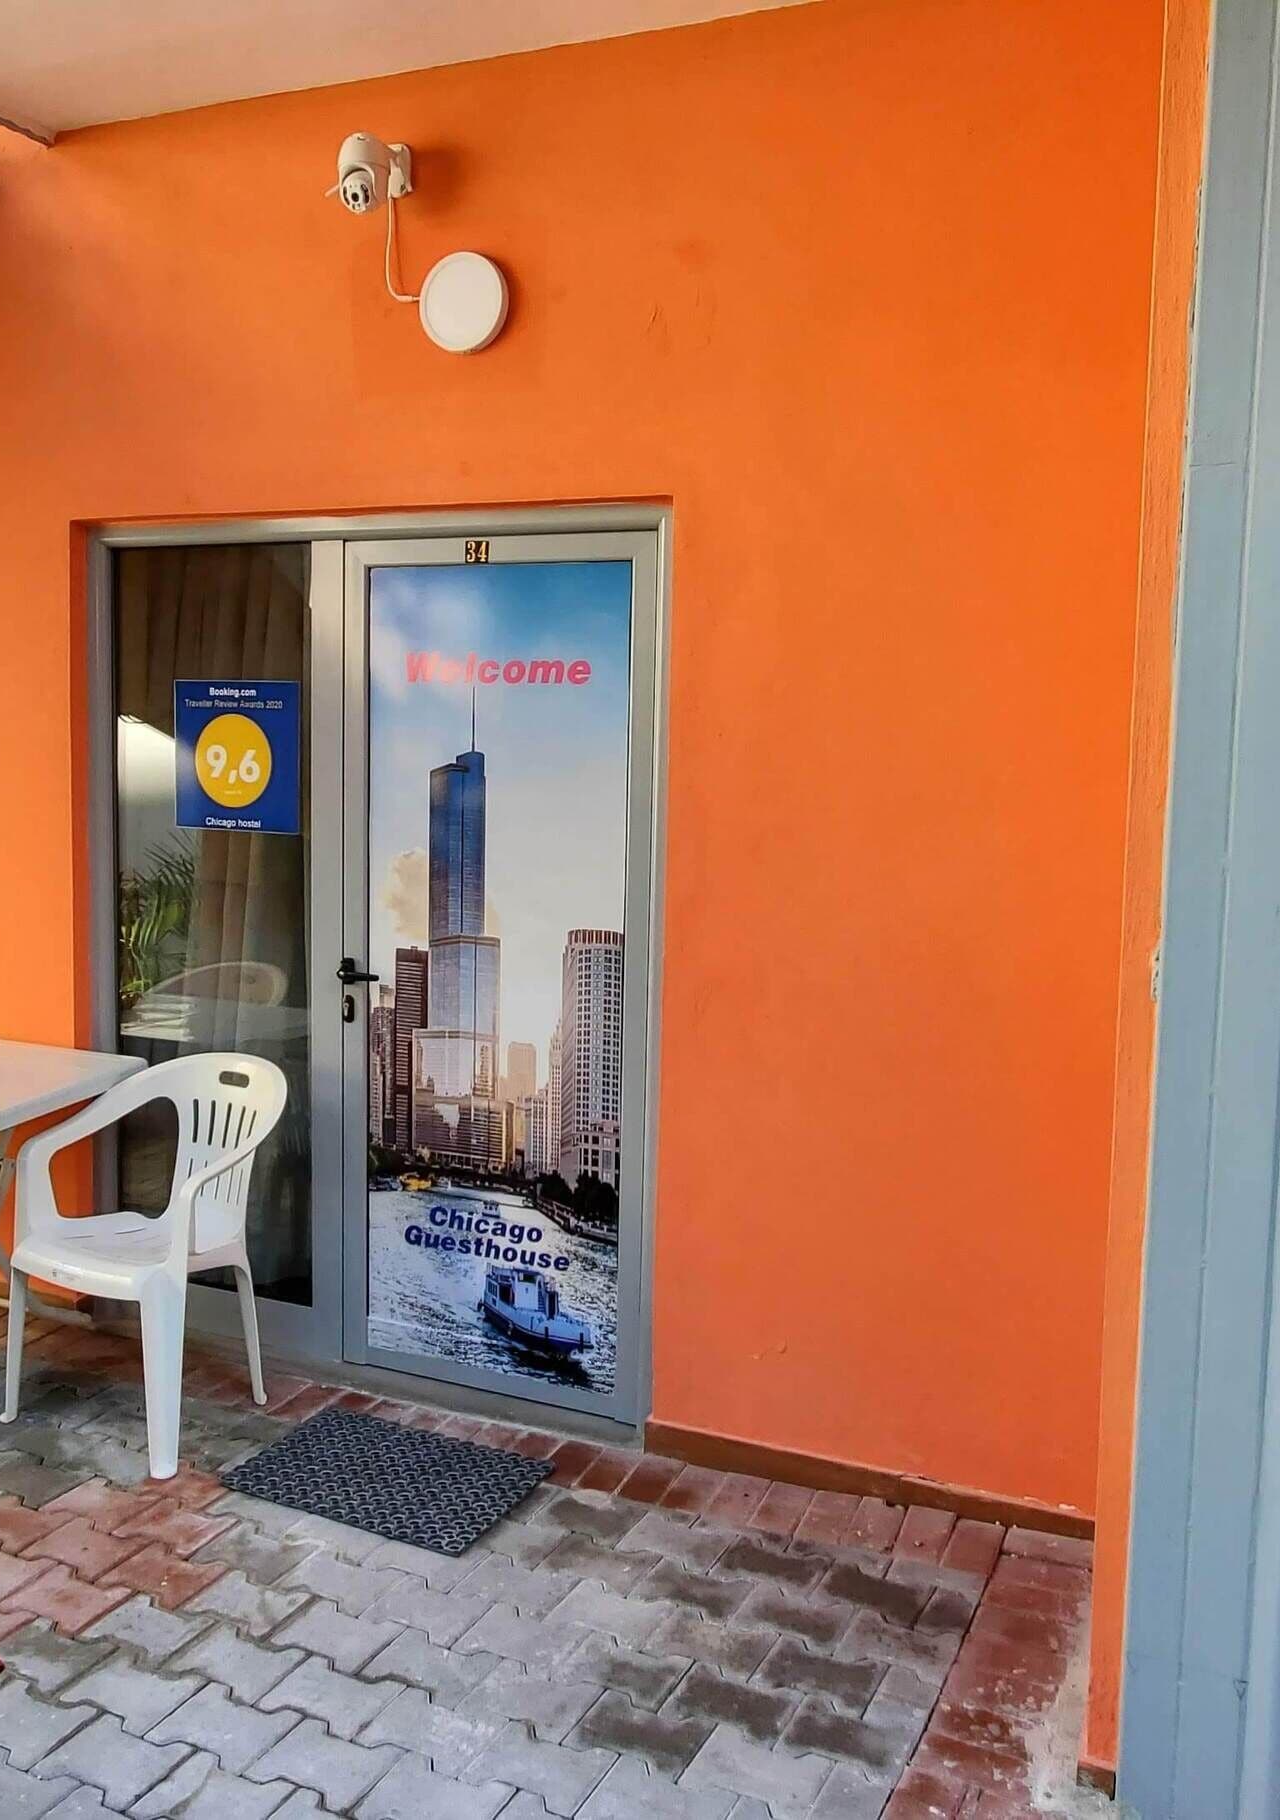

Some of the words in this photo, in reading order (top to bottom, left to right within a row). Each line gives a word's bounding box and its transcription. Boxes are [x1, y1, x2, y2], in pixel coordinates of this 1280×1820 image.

[466, 541, 488, 562] 34
[405, 652, 592, 685] Welcome
[209, 687, 257, 698] Booking.com
[214, 700, 238, 708] Review
[240, 700, 264, 709] Awards
[266, 700, 283, 709] 2020
[206, 744, 261, 784] 9,6
[205, 817, 236, 828] Chicago
[429, 1206, 543, 1244] Chicago
[404, 1225, 571, 1271] Guesthouse
